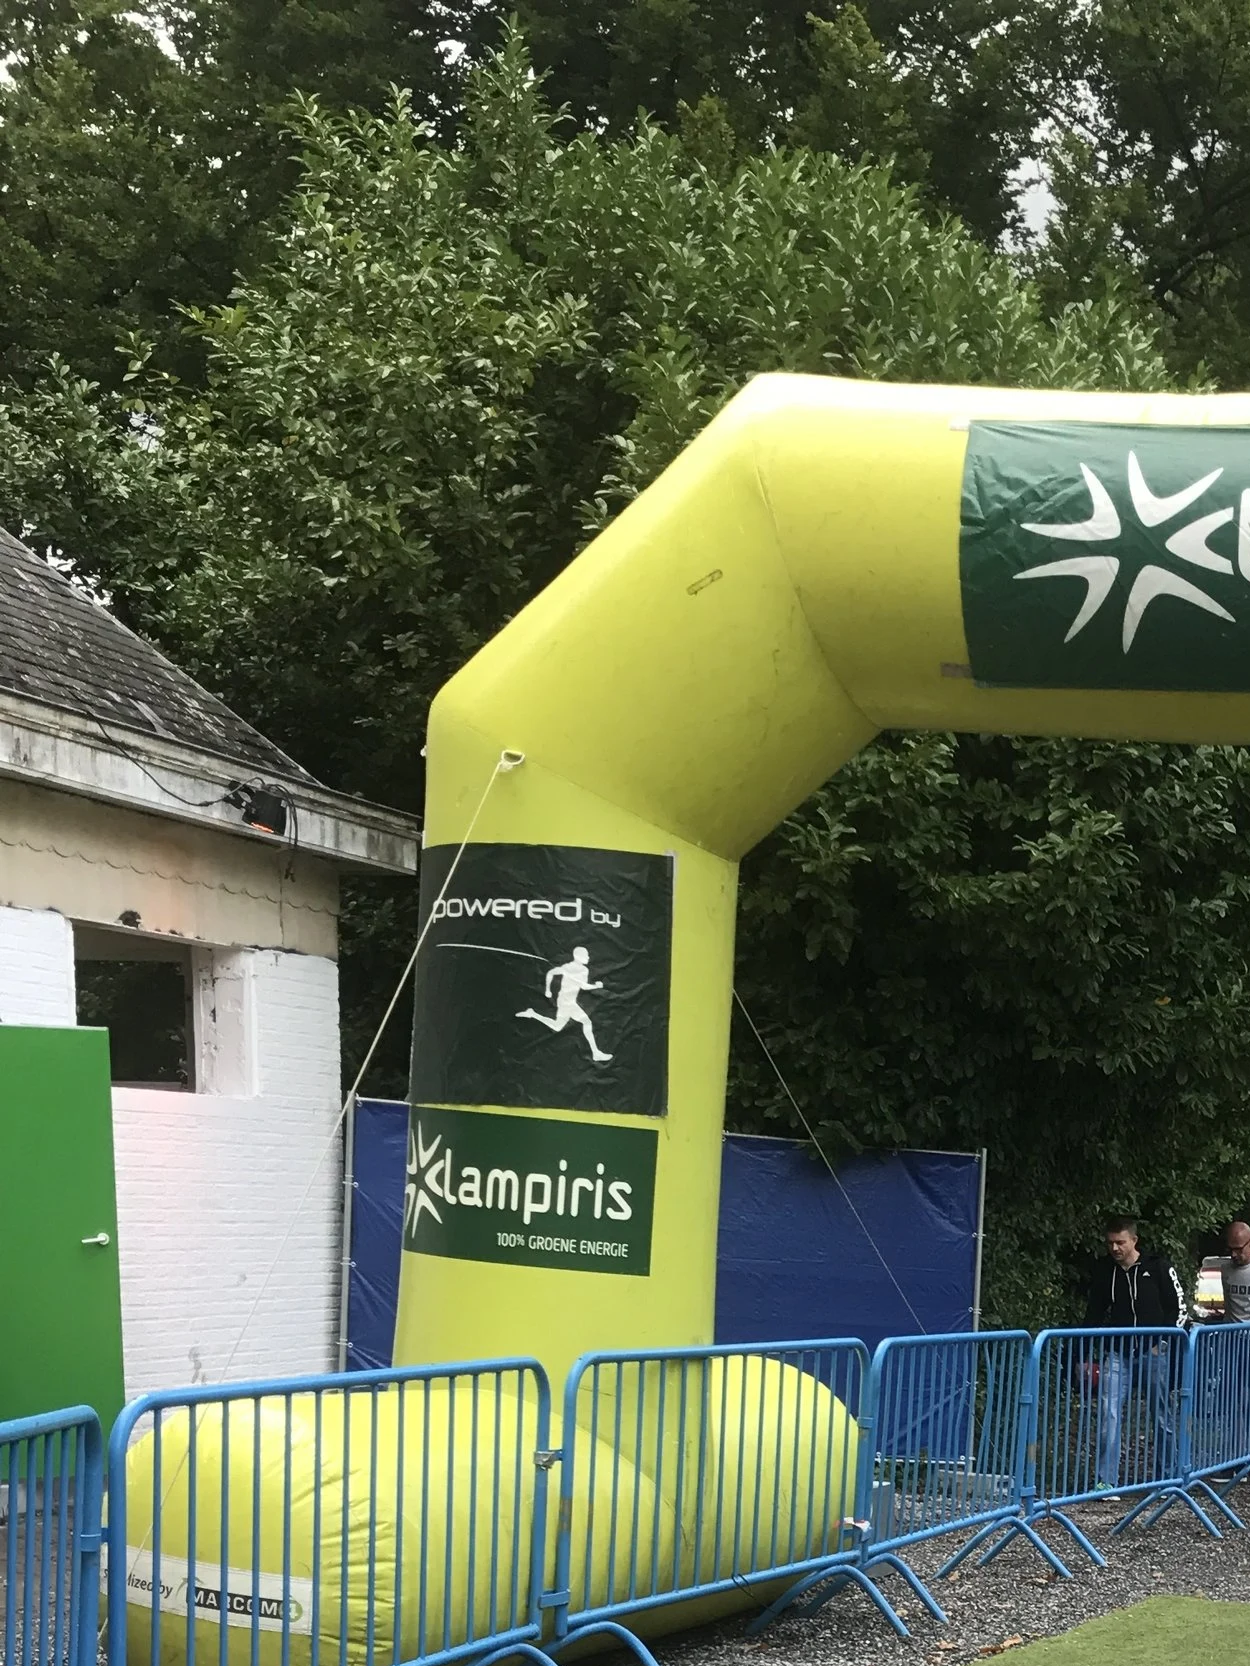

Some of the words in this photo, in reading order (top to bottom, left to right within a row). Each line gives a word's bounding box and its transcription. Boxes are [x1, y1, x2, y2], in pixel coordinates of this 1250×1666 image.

[432, 897, 581, 923] powered
[591, 909, 621, 928] by
[443, 1148, 633, 1225] lampiris
[496, 1232, 525, 1248] 100%
[528, 1235, 576, 1253] GROENE
[579, 1239, 629, 1258] ENERGIE
